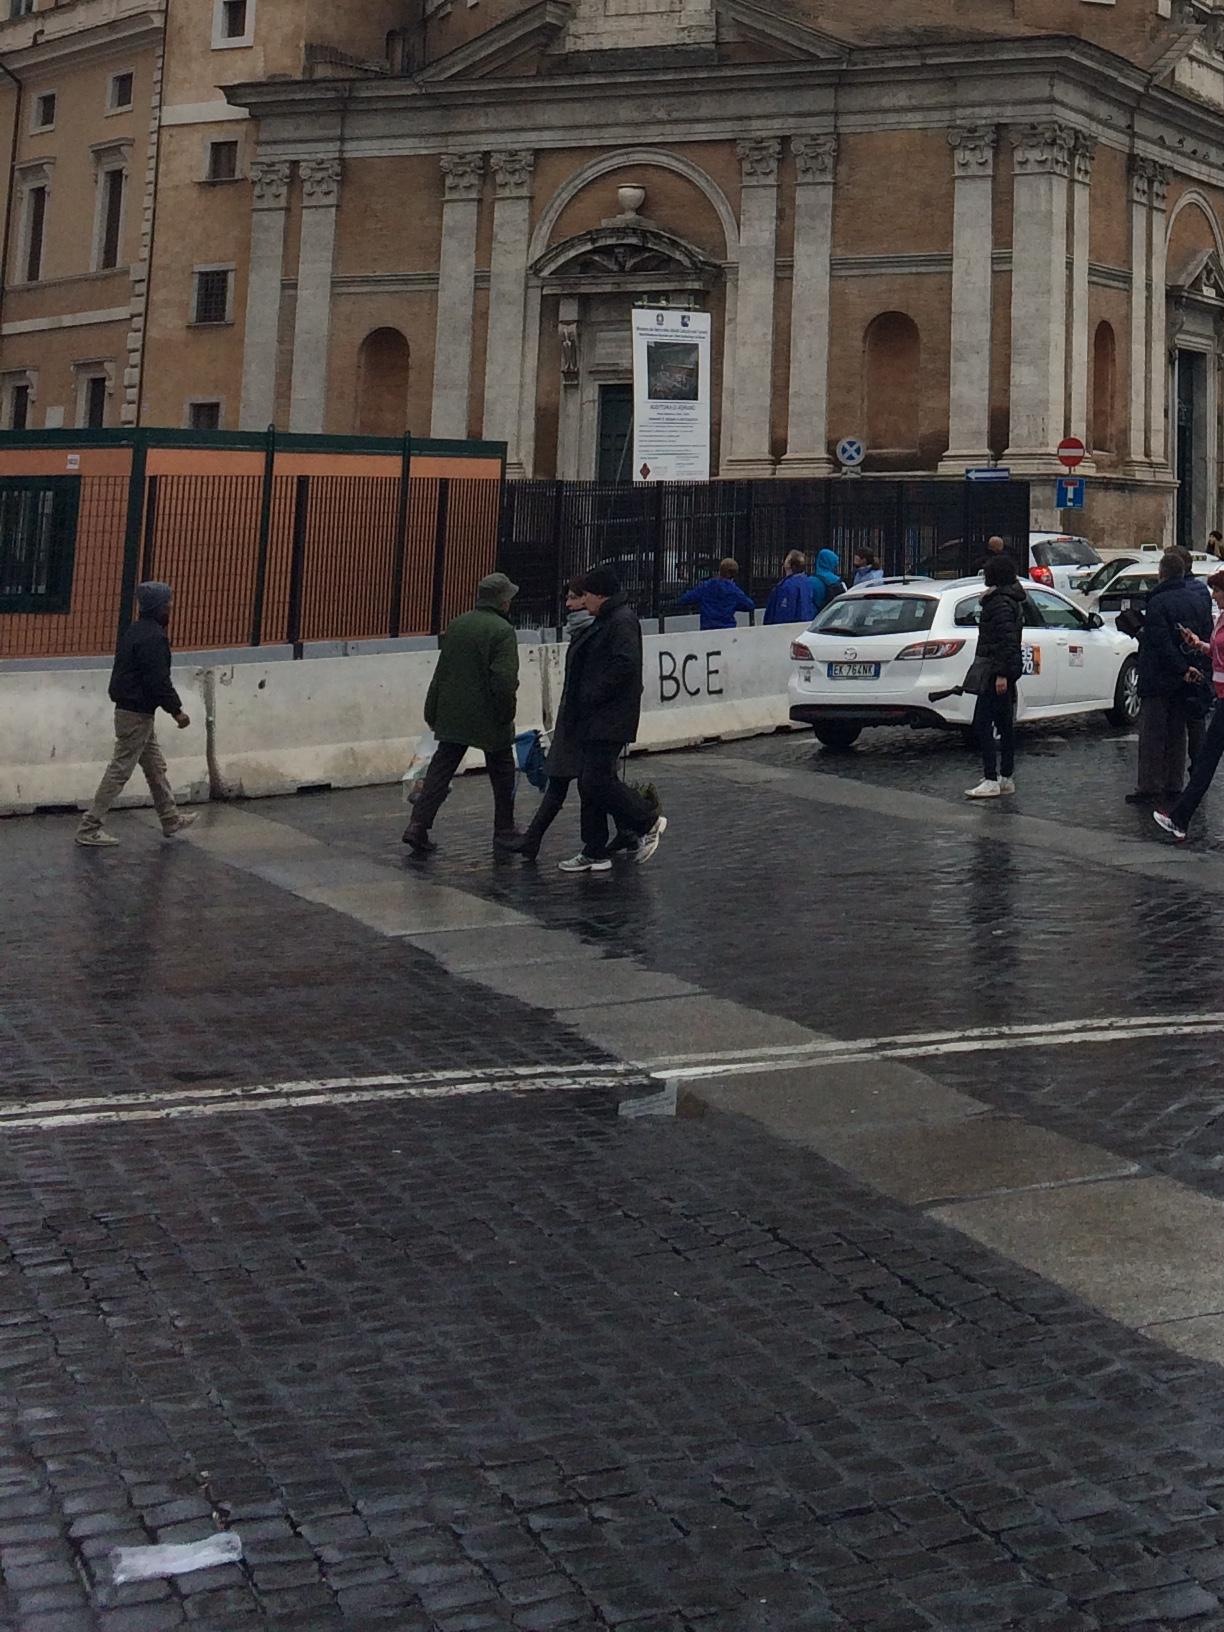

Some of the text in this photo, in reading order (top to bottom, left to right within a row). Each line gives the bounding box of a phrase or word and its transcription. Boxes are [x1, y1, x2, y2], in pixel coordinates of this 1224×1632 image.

[1021, 647, 1033, 660] 35
[1022, 660, 1034, 673] 70
[659, 650, 723, 703] BCE
